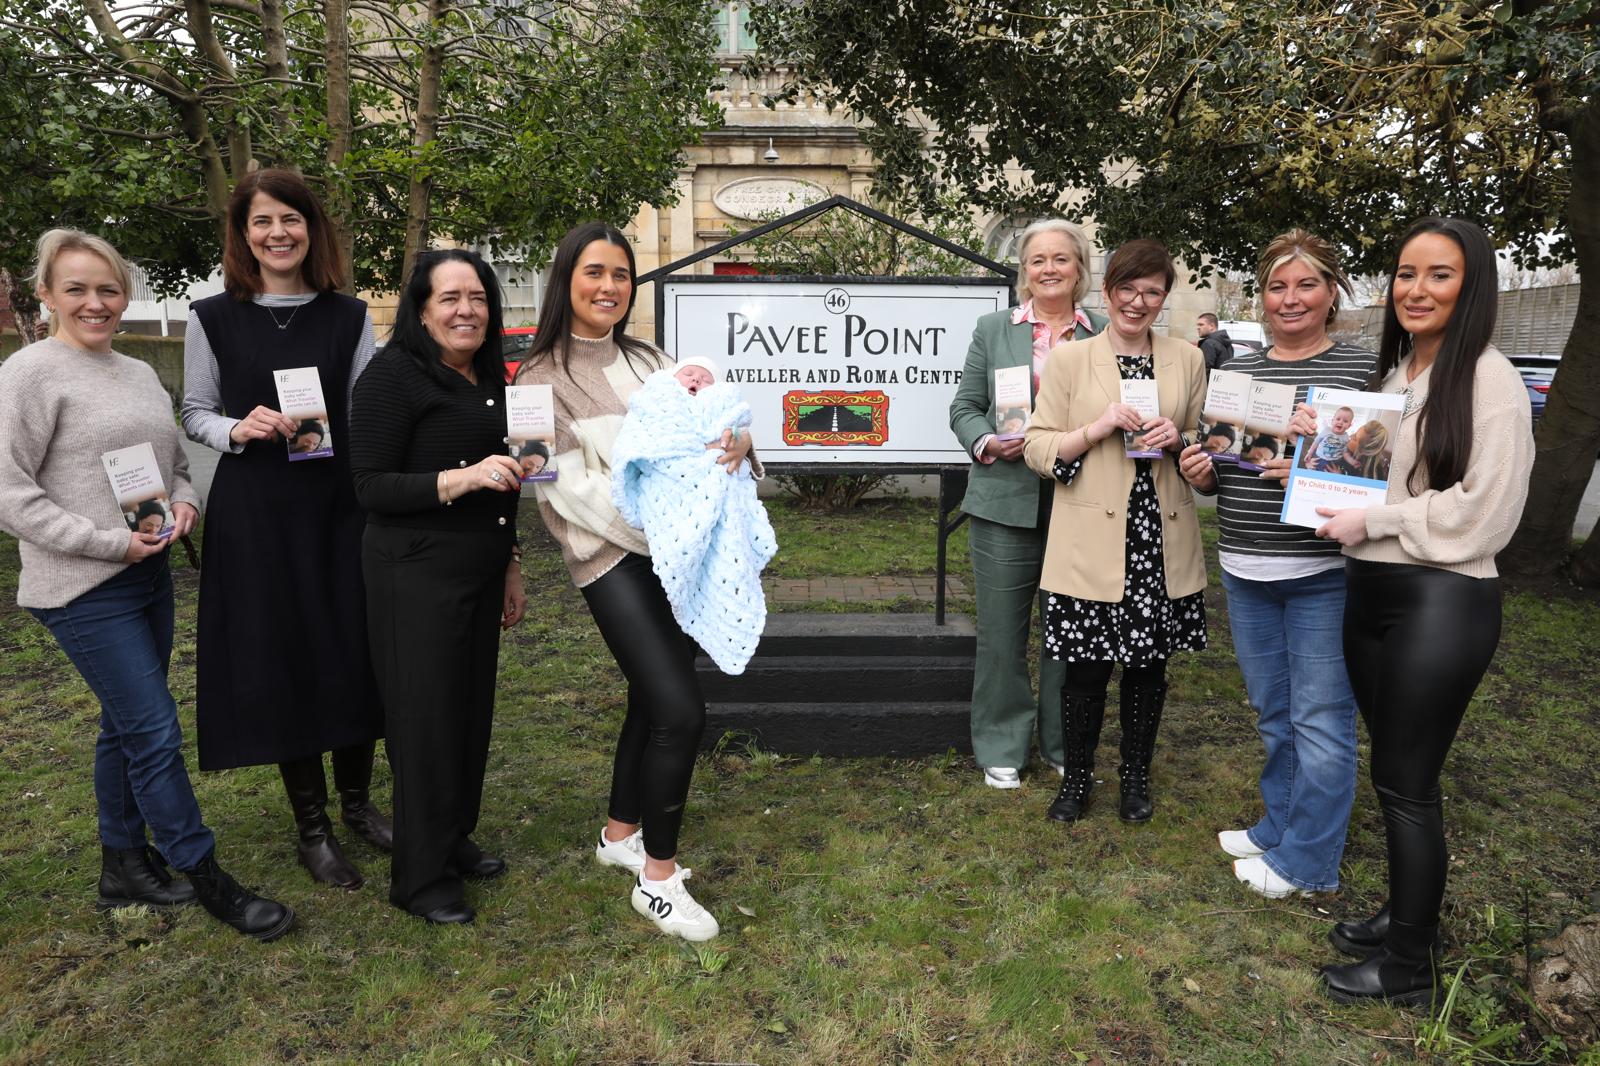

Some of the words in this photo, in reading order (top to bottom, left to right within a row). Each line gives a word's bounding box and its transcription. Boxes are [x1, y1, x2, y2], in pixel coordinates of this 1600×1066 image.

[827, 293, 846, 308] 46
[727, 312, 828, 356] PAVEE
[844, 314, 946, 357] POINT
[726, 368, 801, 383] AVELLER
[806, 368, 840, 383] AND
[846, 365, 899, 384] ROMA
[905, 366, 964, 384] CENTR
[1298, 480, 1307, 488] My
[1308, 481, 1326, 489] Child:
